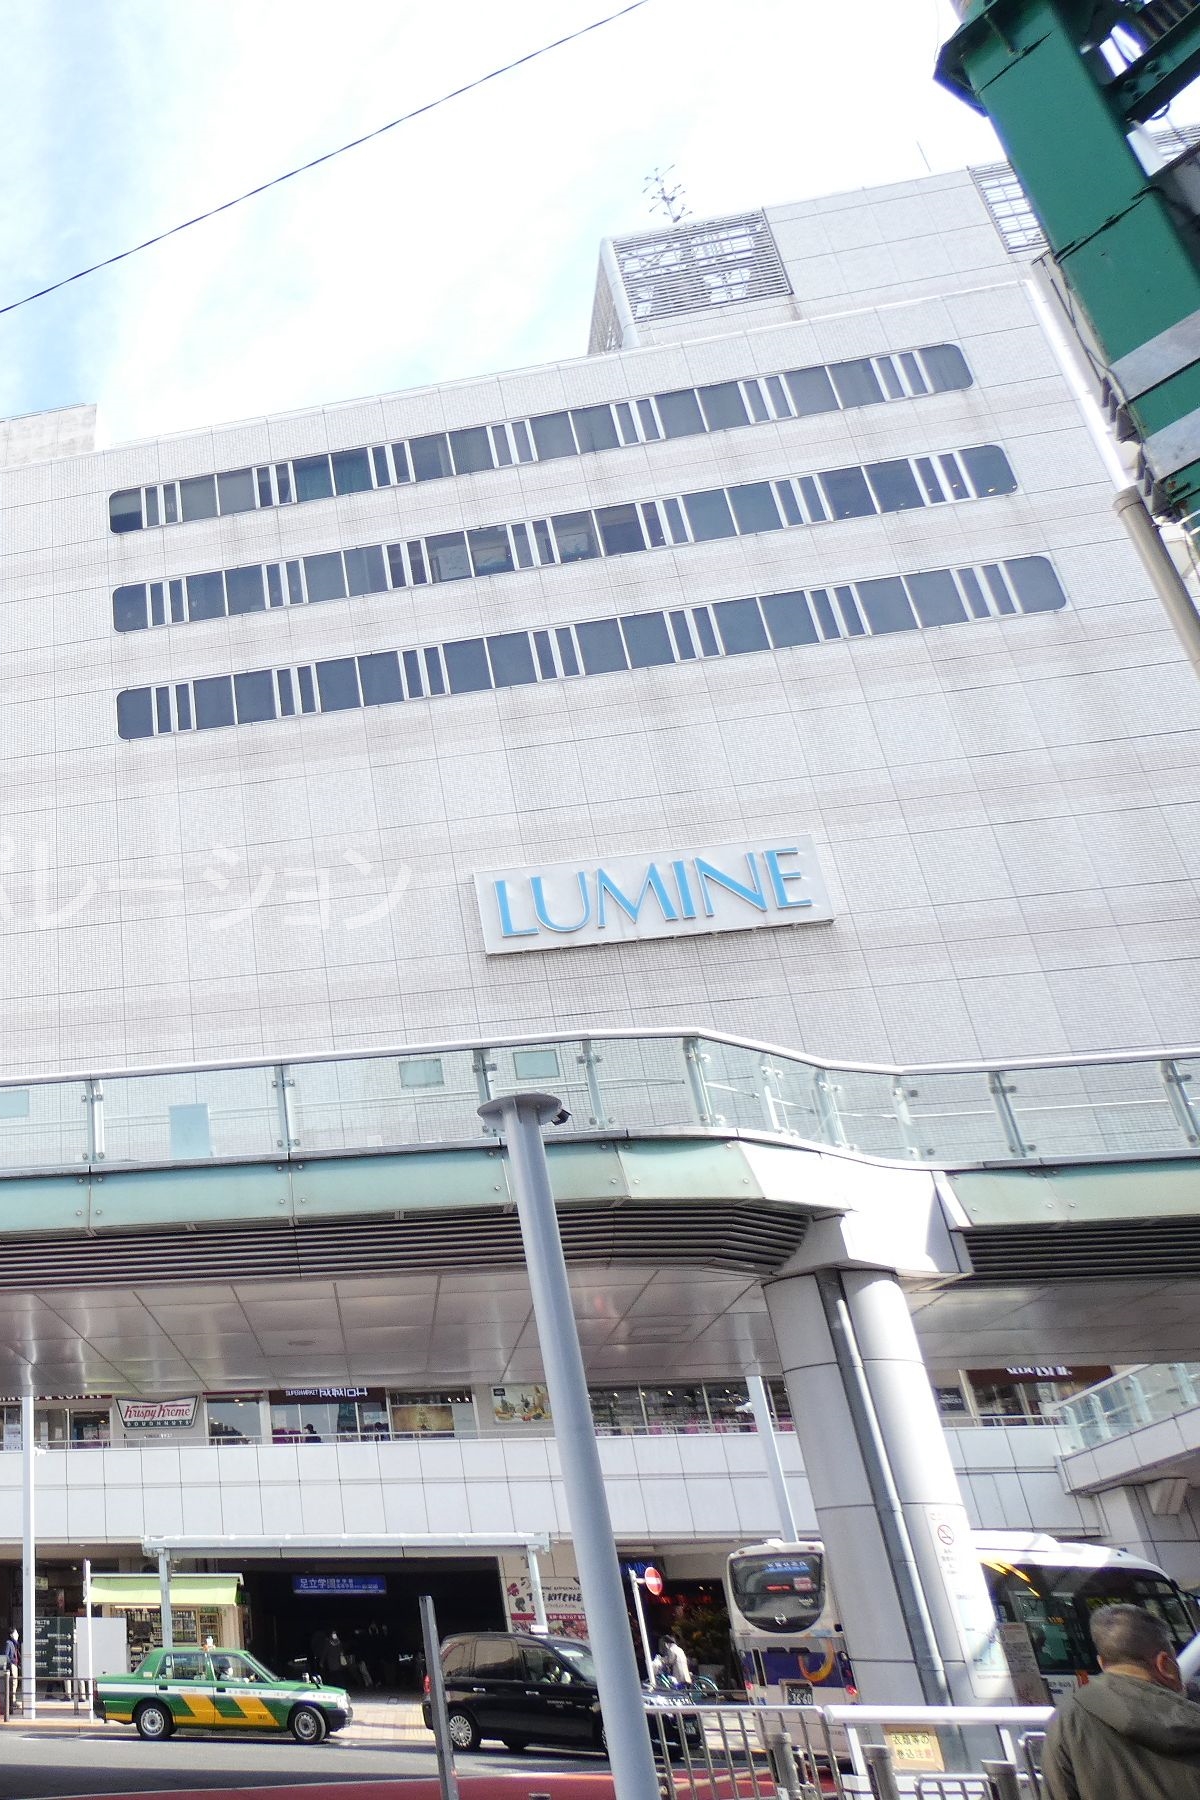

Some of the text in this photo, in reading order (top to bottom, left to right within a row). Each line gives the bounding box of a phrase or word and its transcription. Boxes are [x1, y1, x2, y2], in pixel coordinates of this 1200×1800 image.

[493, 846, 813, 938] LUMINE
[124, 1403, 191, 1420] Krispy Kreme
[126, 1420, 190, 1428] DOUGHNUTS
[299, 1577, 336, 1589] 足立学園
[547, 1592, 582, 1603] KITCHE
